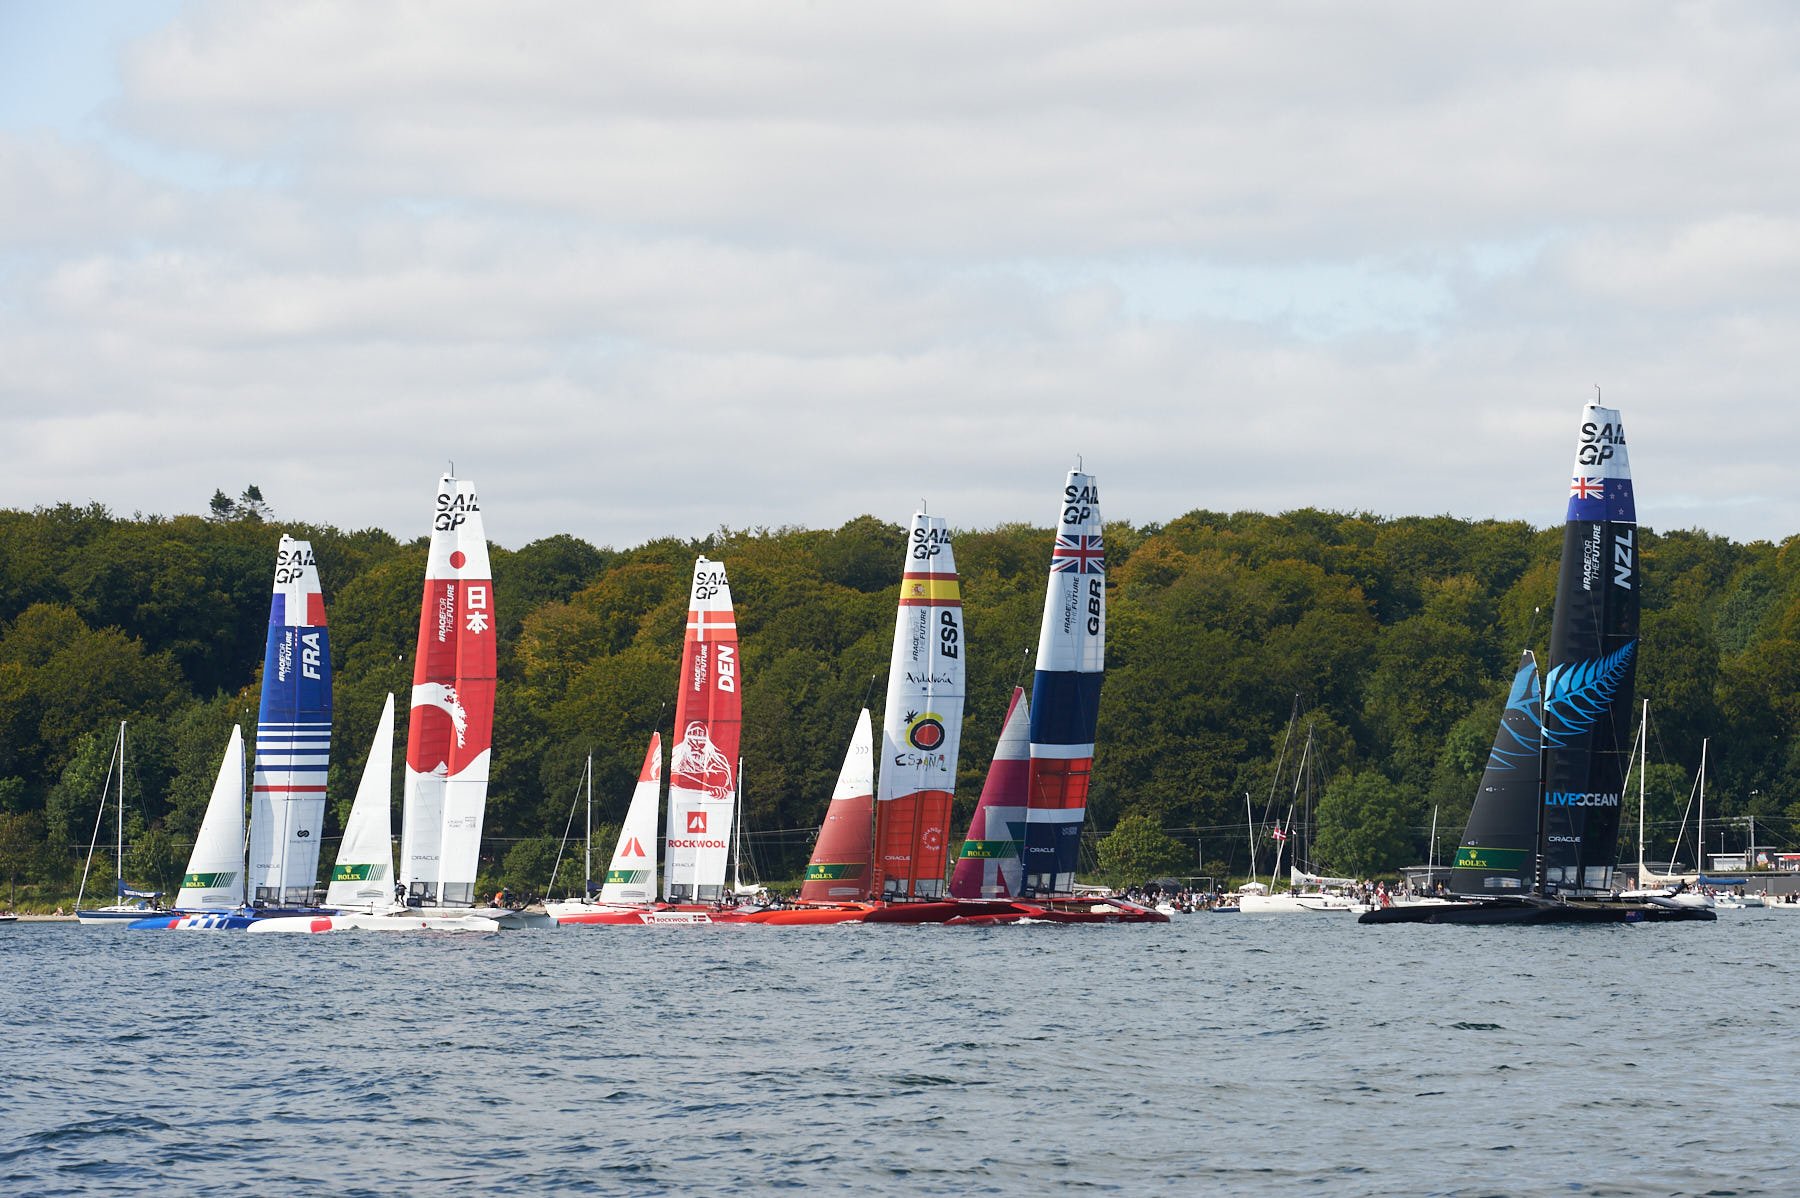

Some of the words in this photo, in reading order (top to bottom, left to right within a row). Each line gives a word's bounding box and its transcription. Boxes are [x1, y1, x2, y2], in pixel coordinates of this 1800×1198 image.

[1578, 444, 1614, 466] GP
[434, 513, 465, 531] GP
[1063, 506, 1091, 525] GP
[912, 544, 941, 560] GP
[1614, 529, 1633, 590] NZL
[276, 568, 304, 584] GP
[695, 586, 718, 600] GP
[466, 586, 489, 635] 日本
[1087, 578, 1102, 636] GBR
[941, 610, 958, 660] ESP
[301, 632, 321, 681] FRA
[718, 645, 735, 693] DEN
[668, 839, 726, 849] ROCKWOOL
[1459, 859, 1488, 867] ROLEX
[338, 873, 361, 881] ROLEX
